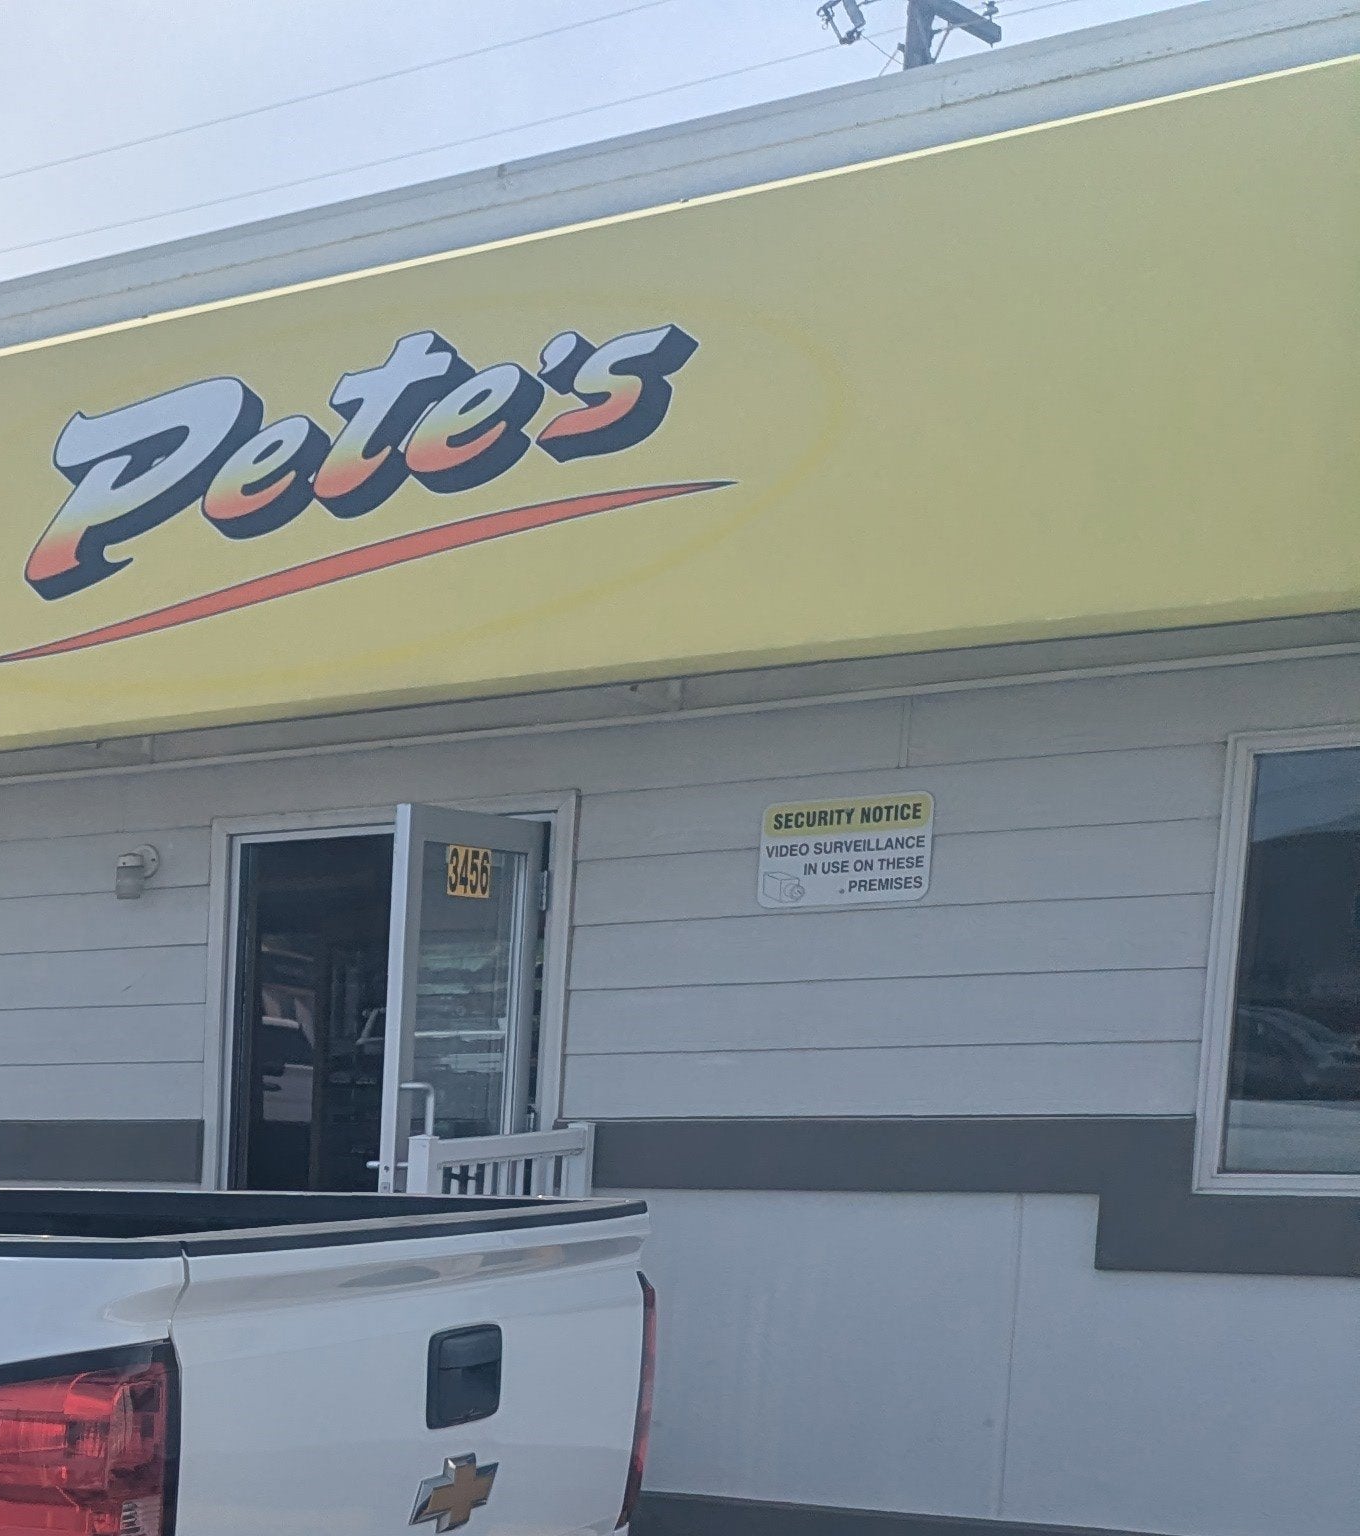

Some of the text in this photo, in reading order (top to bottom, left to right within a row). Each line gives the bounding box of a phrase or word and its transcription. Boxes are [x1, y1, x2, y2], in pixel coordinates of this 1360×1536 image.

[24, 323, 700, 602] Pete's
[773, 802, 922, 831] SECURITY NOTICE
[766, 835, 926, 858] VIDEO SURVEILLANCE
[448, 847, 490, 895] 3456
[803, 855, 925, 876] IN USE ON THESE
[848, 876, 923, 894] PREMISES
